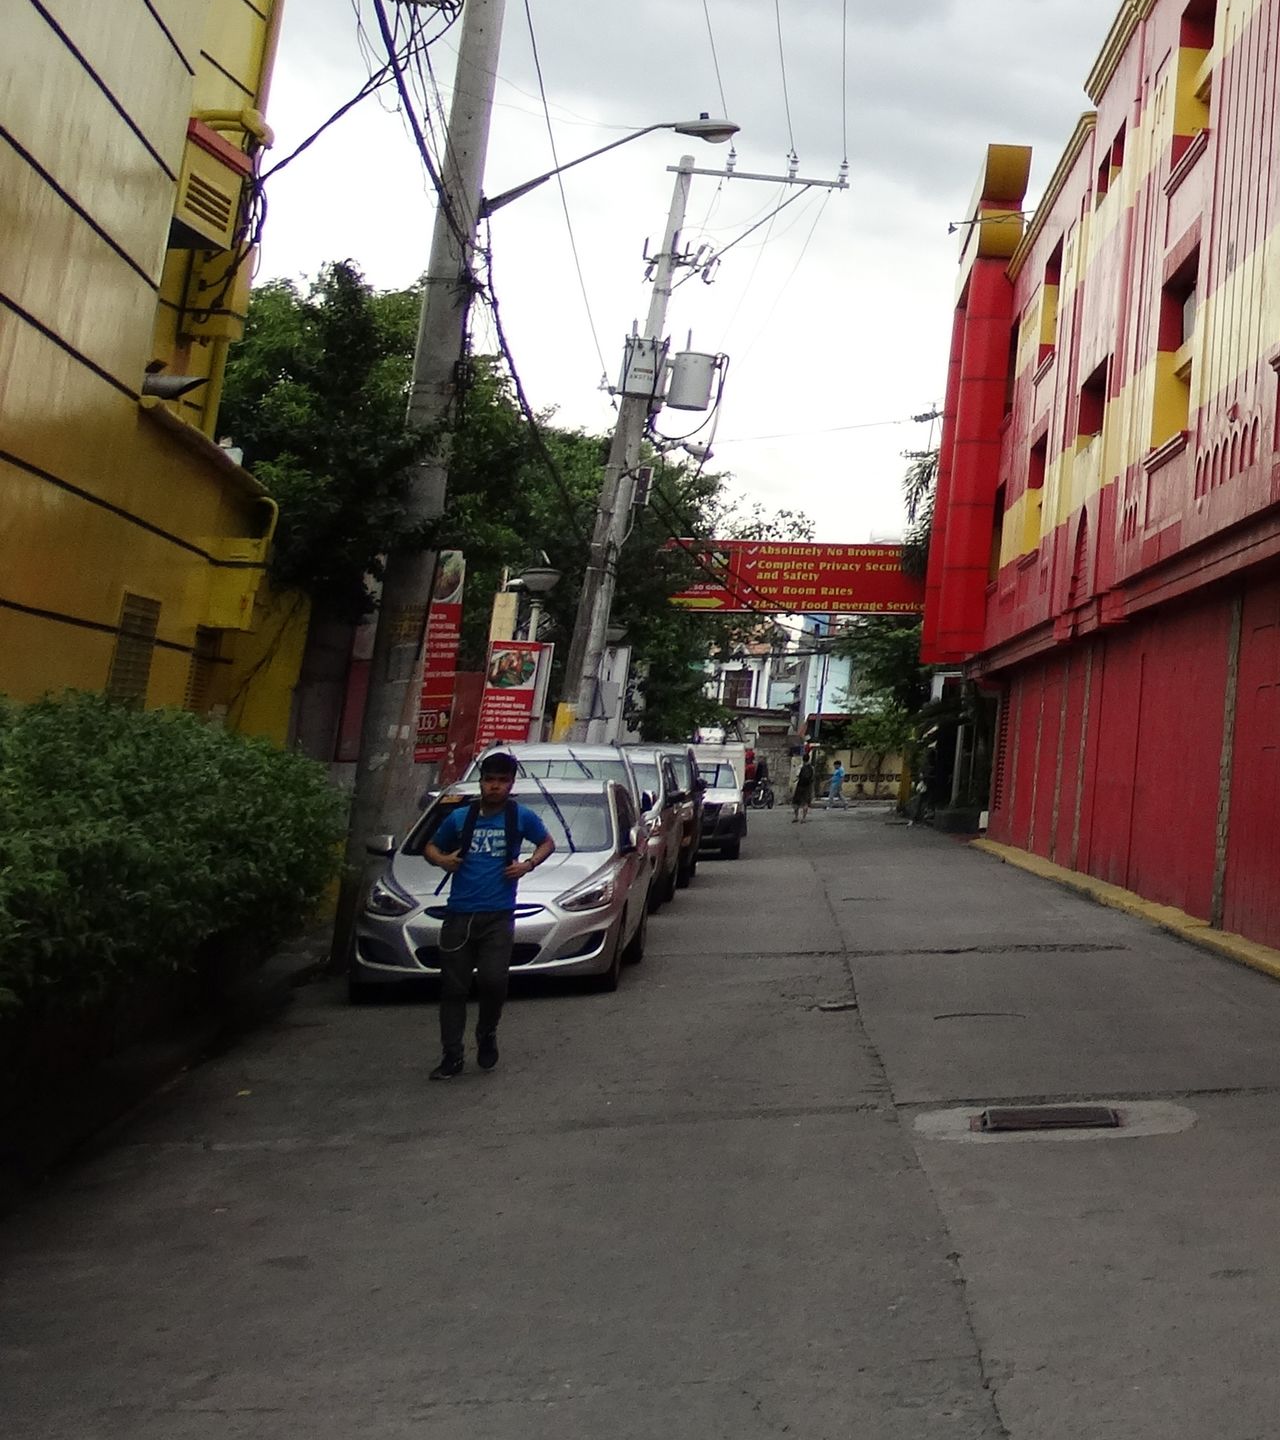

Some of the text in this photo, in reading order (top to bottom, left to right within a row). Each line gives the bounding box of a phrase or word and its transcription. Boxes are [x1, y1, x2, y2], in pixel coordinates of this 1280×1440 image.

[759, 545, 823, 557] Absolutely
[827, 547, 843, 556] No
[757, 560, 815, 571] Complete
[819, 562, 861, 572] Privacy
[756, 571, 820, 582] and Safety
[782, 586, 816, 595] Room
[821, 586, 854, 596] Rates
[801, 601, 828, 610] Food
[832, 601, 883, 612] Beverage
